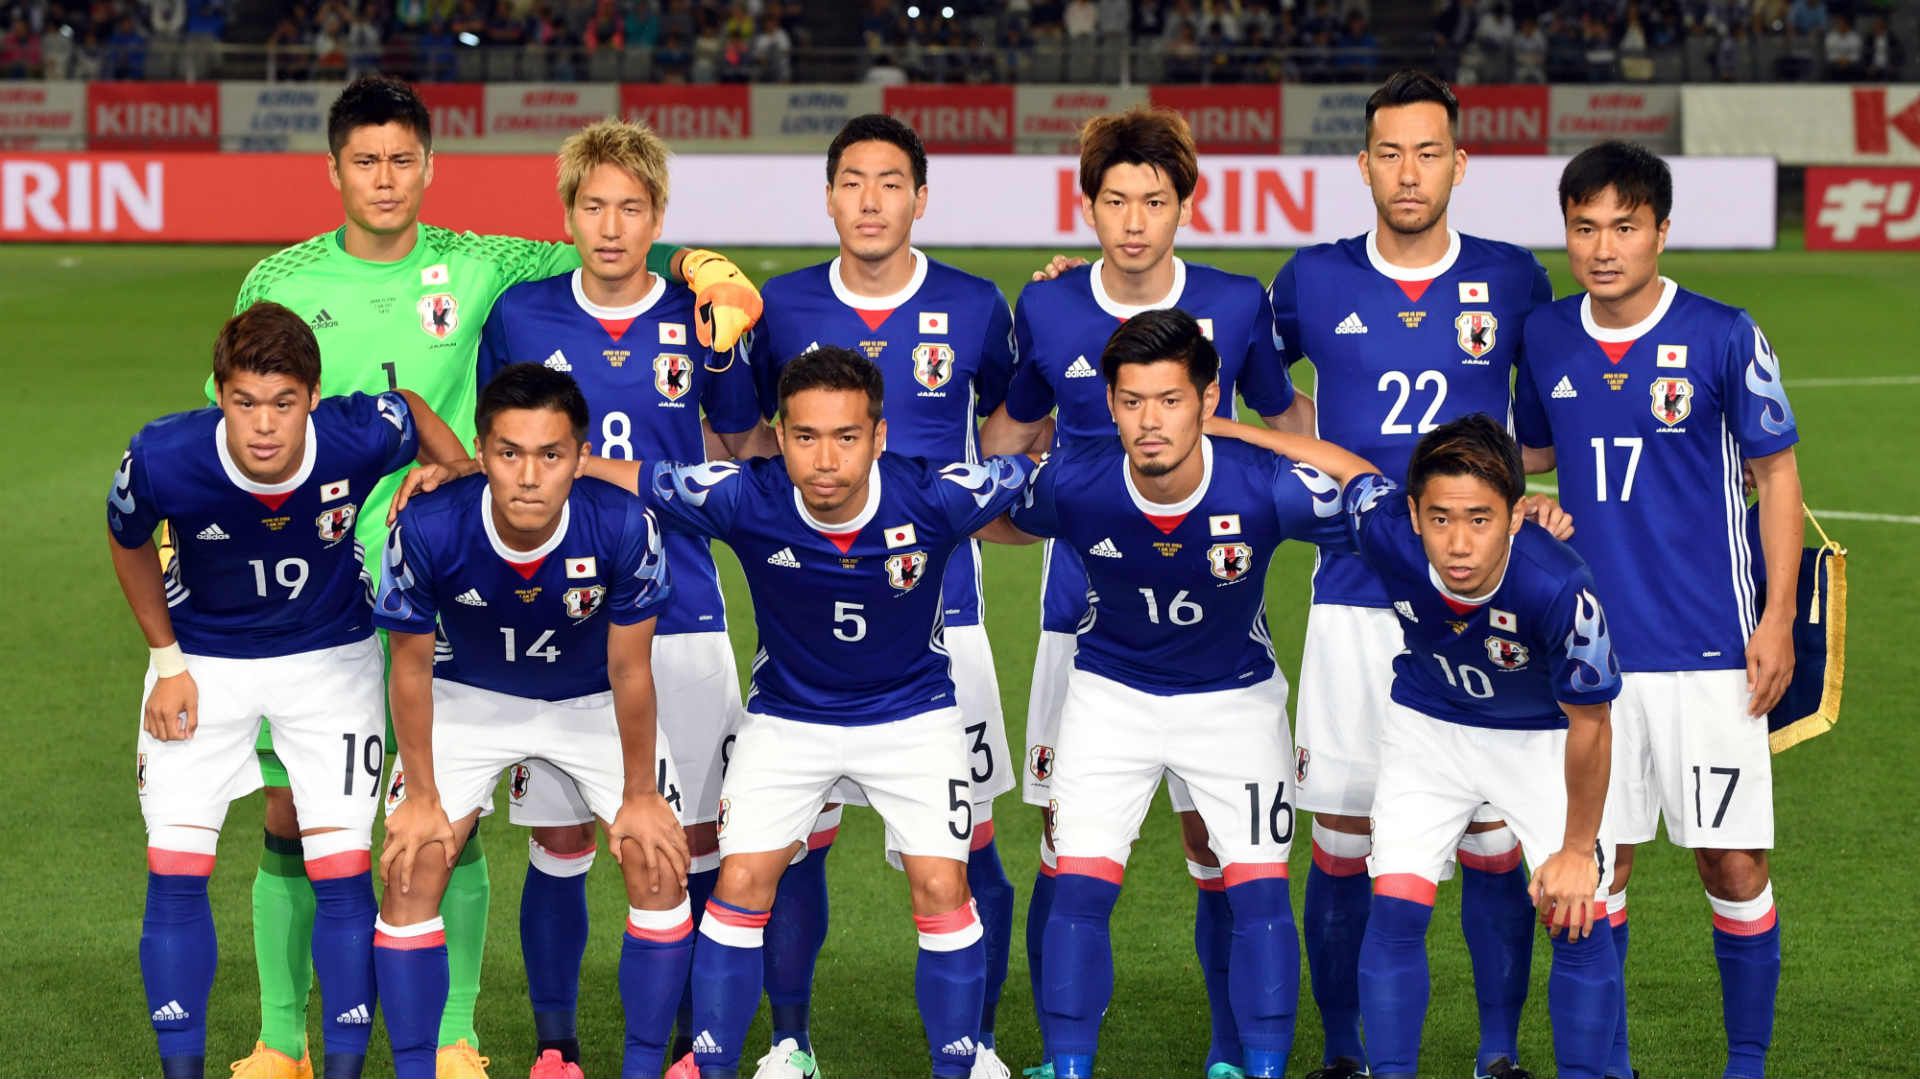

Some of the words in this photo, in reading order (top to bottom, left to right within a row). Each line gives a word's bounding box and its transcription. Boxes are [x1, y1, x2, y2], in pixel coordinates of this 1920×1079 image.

[0, 88, 47, 104] IRIN
[96, 103, 212, 138] KIRIN
[1189, 107, 1273, 141] IRIN
[1457, 107, 1541, 140] IRIN
[2, 161, 163, 232] RIN
[1057, 169, 1316, 233] KIN
[1334, 325, 1369, 335] adidas
[381, 361, 397, 390] 1
[1064, 368, 1097, 379] adidas
[1551, 388, 1578, 399] adidas
[1377, 369, 1449, 436] 22
[601, 411, 634, 461] 8
[1590, 436, 1643, 502] 17
[196, 532, 231, 541] adidas
[1089, 547, 1123, 559] adidas
[248, 557, 310, 601] 19
[767, 556, 801, 569] adidas
[832, 601, 868, 643] 5
[1138, 587, 1204, 627] 16
[499, 626, 562, 664] 14
[1432, 653, 1495, 699] 10
[342, 732, 383, 798] 19
[964, 720, 994, 783] 3
[948, 778, 973, 841] 5
[1245, 780, 1293, 844] 16
[1693, 765, 1741, 829] 17
[152, 1011, 190, 1021] adidas
